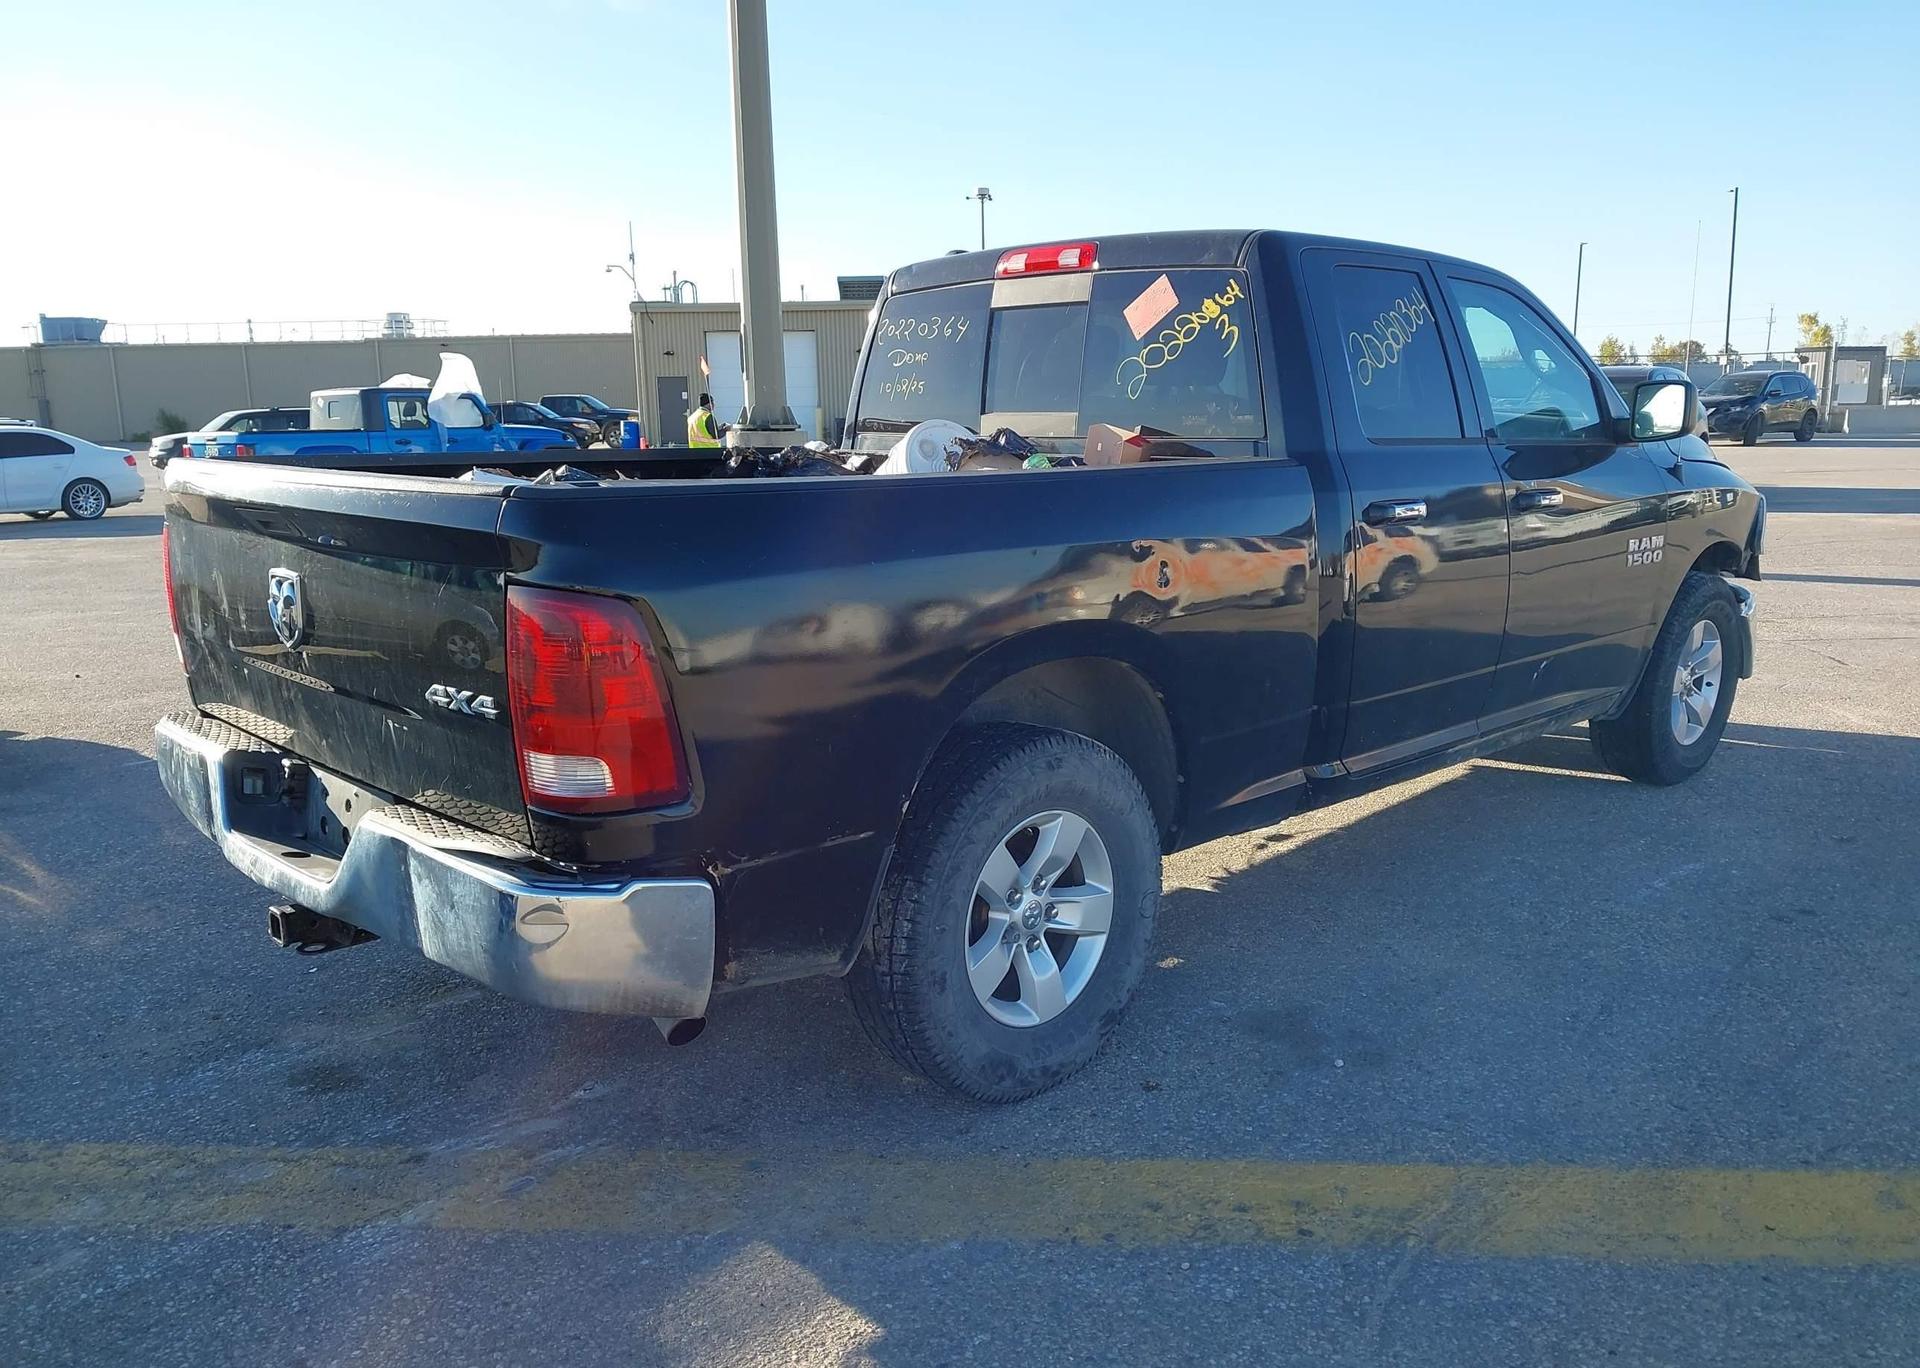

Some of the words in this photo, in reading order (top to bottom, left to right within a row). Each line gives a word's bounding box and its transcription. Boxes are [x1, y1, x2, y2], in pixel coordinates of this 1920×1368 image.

[877, 315, 970, 346] 20220364
[1214, 313, 1239, 358] 3
[1349, 286, 1436, 386] 20220364
[879, 372, 925, 402] 10/08/25
[1628, 535, 1665, 551] RAM
[1626, 549, 1663, 568] 1500
